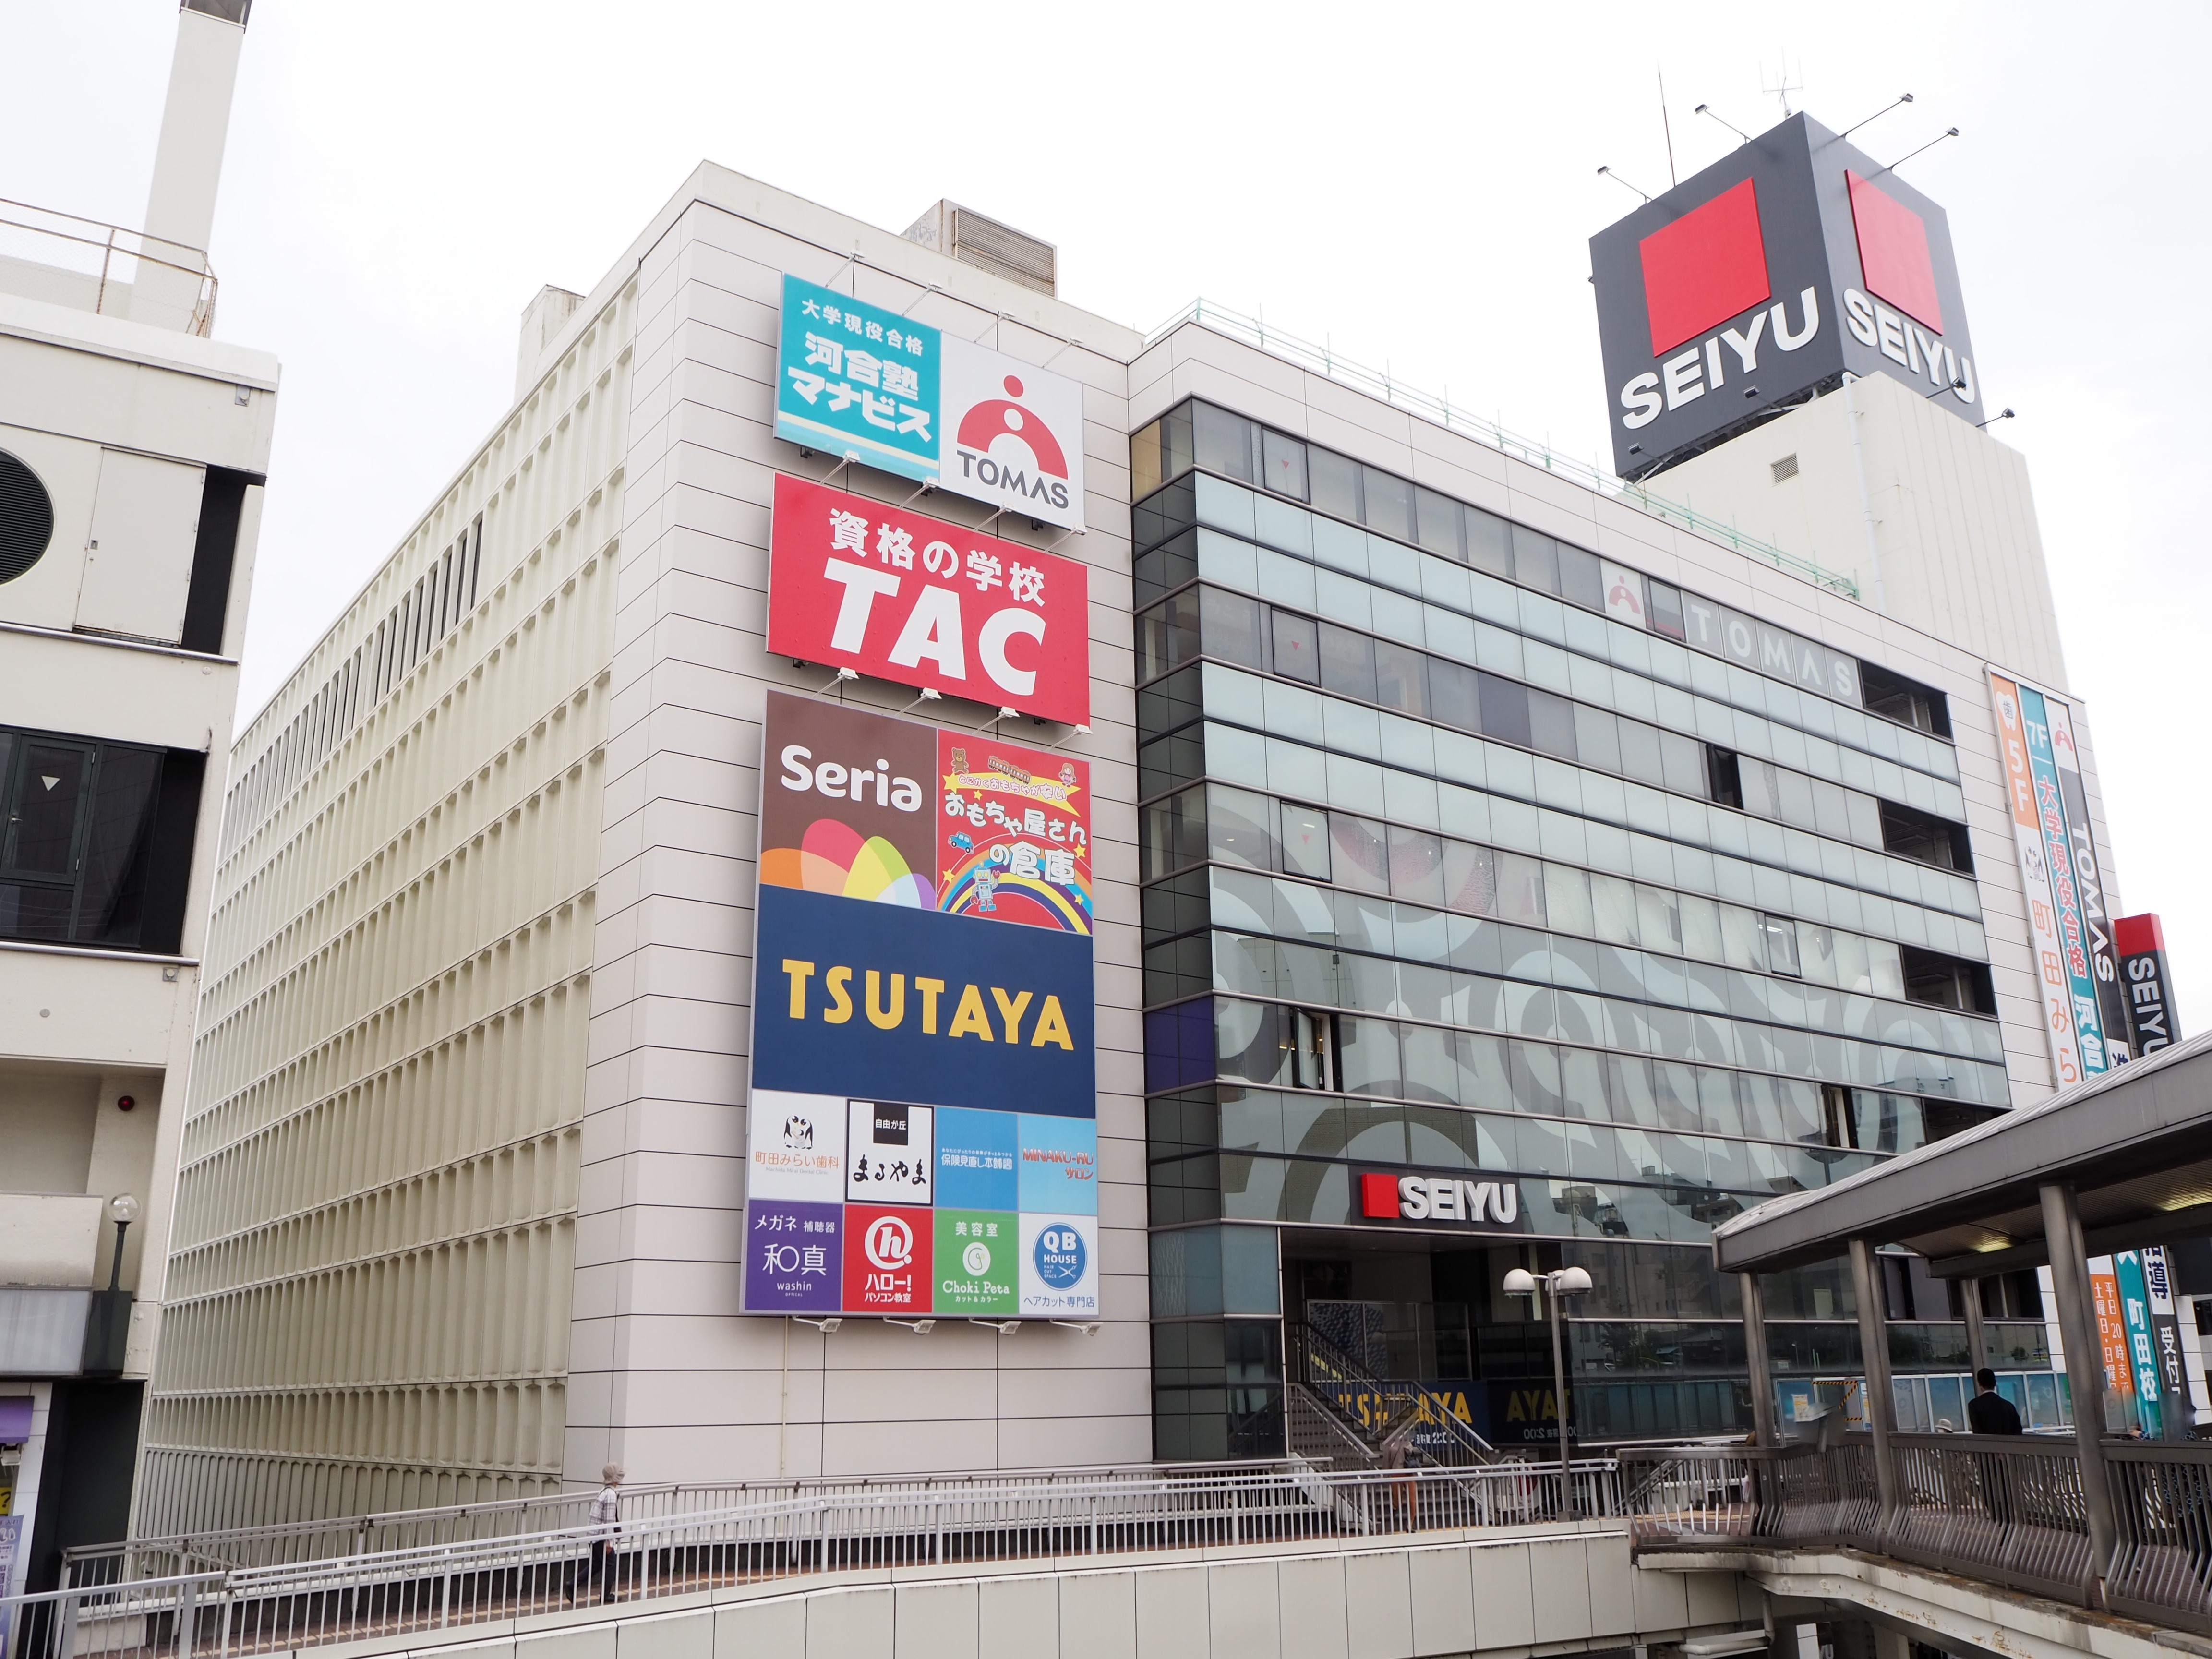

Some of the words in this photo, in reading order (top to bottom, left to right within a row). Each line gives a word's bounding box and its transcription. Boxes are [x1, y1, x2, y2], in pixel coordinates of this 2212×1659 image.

[802, 299, 923, 357] 大学現役合格
[1843, 289, 1975, 404] SEIYU
[805, 331, 918, 401] 河合塾
[1620, 287, 1819, 430] SEIYU
[788, 366, 931, 443] マナビス
[957, 450, 1069, 509] TOMAS
[830, 508, 1045, 607] 資格の学校
[824, 557, 1046, 696] TAC
[1691, 604, 1853, 696] TOMAS
[2026, 720, 2048, 748] 7F
[781, 745, 922, 812] Seria
[959, 775, 1067, 801] とにかくおもちゃが安い
[945, 792, 1087, 845] おもちゃ屋さん
[989, 841, 1075, 886] の倉庫
[2037, 775, 2088, 978] 大学現役合格
[2072, 822, 2114, 982] TOMAS
[782, 959, 1074, 1050] TSUTAYA
[2074, 994, 2106, 1080] 河合
[875, 1118, 906, 1130] 自由が丘
[755, 1151, 839, 1169] 町田みらい歯科
[853, 1154, 926, 1185] まるやま
[941, 1154, 1003, 1169] 保険見直し本舗
[1022, 1148, 1094, 1165] MINAKU-RU
[1065, 1167, 1094, 1180] サロン
[1398, 1176, 1517, 1223] SEIYU
[755, 1215, 797, 1231] メガネ
[803, 1221, 835, 1233] 補聴器
[955, 1221, 998, 1237] 美容室
[1043, 1231, 1076, 1253] QB
[762, 1243, 826, 1275] 和真
[1044, 1254, 1077, 1263] HOUSE
[777, 1281, 812, 1291] washin
[865, 1292, 911, 1303] パソコン教室
[942, 1280, 979, 1293] Choki
[983, 1281, 1010, 1294] Peta
[1024, 1296, 1094, 1308] ヘアカット専門店
[2127, 1298, 2157, 1401] 町田校
[2160, 1326, 2180, 1394] 受付
